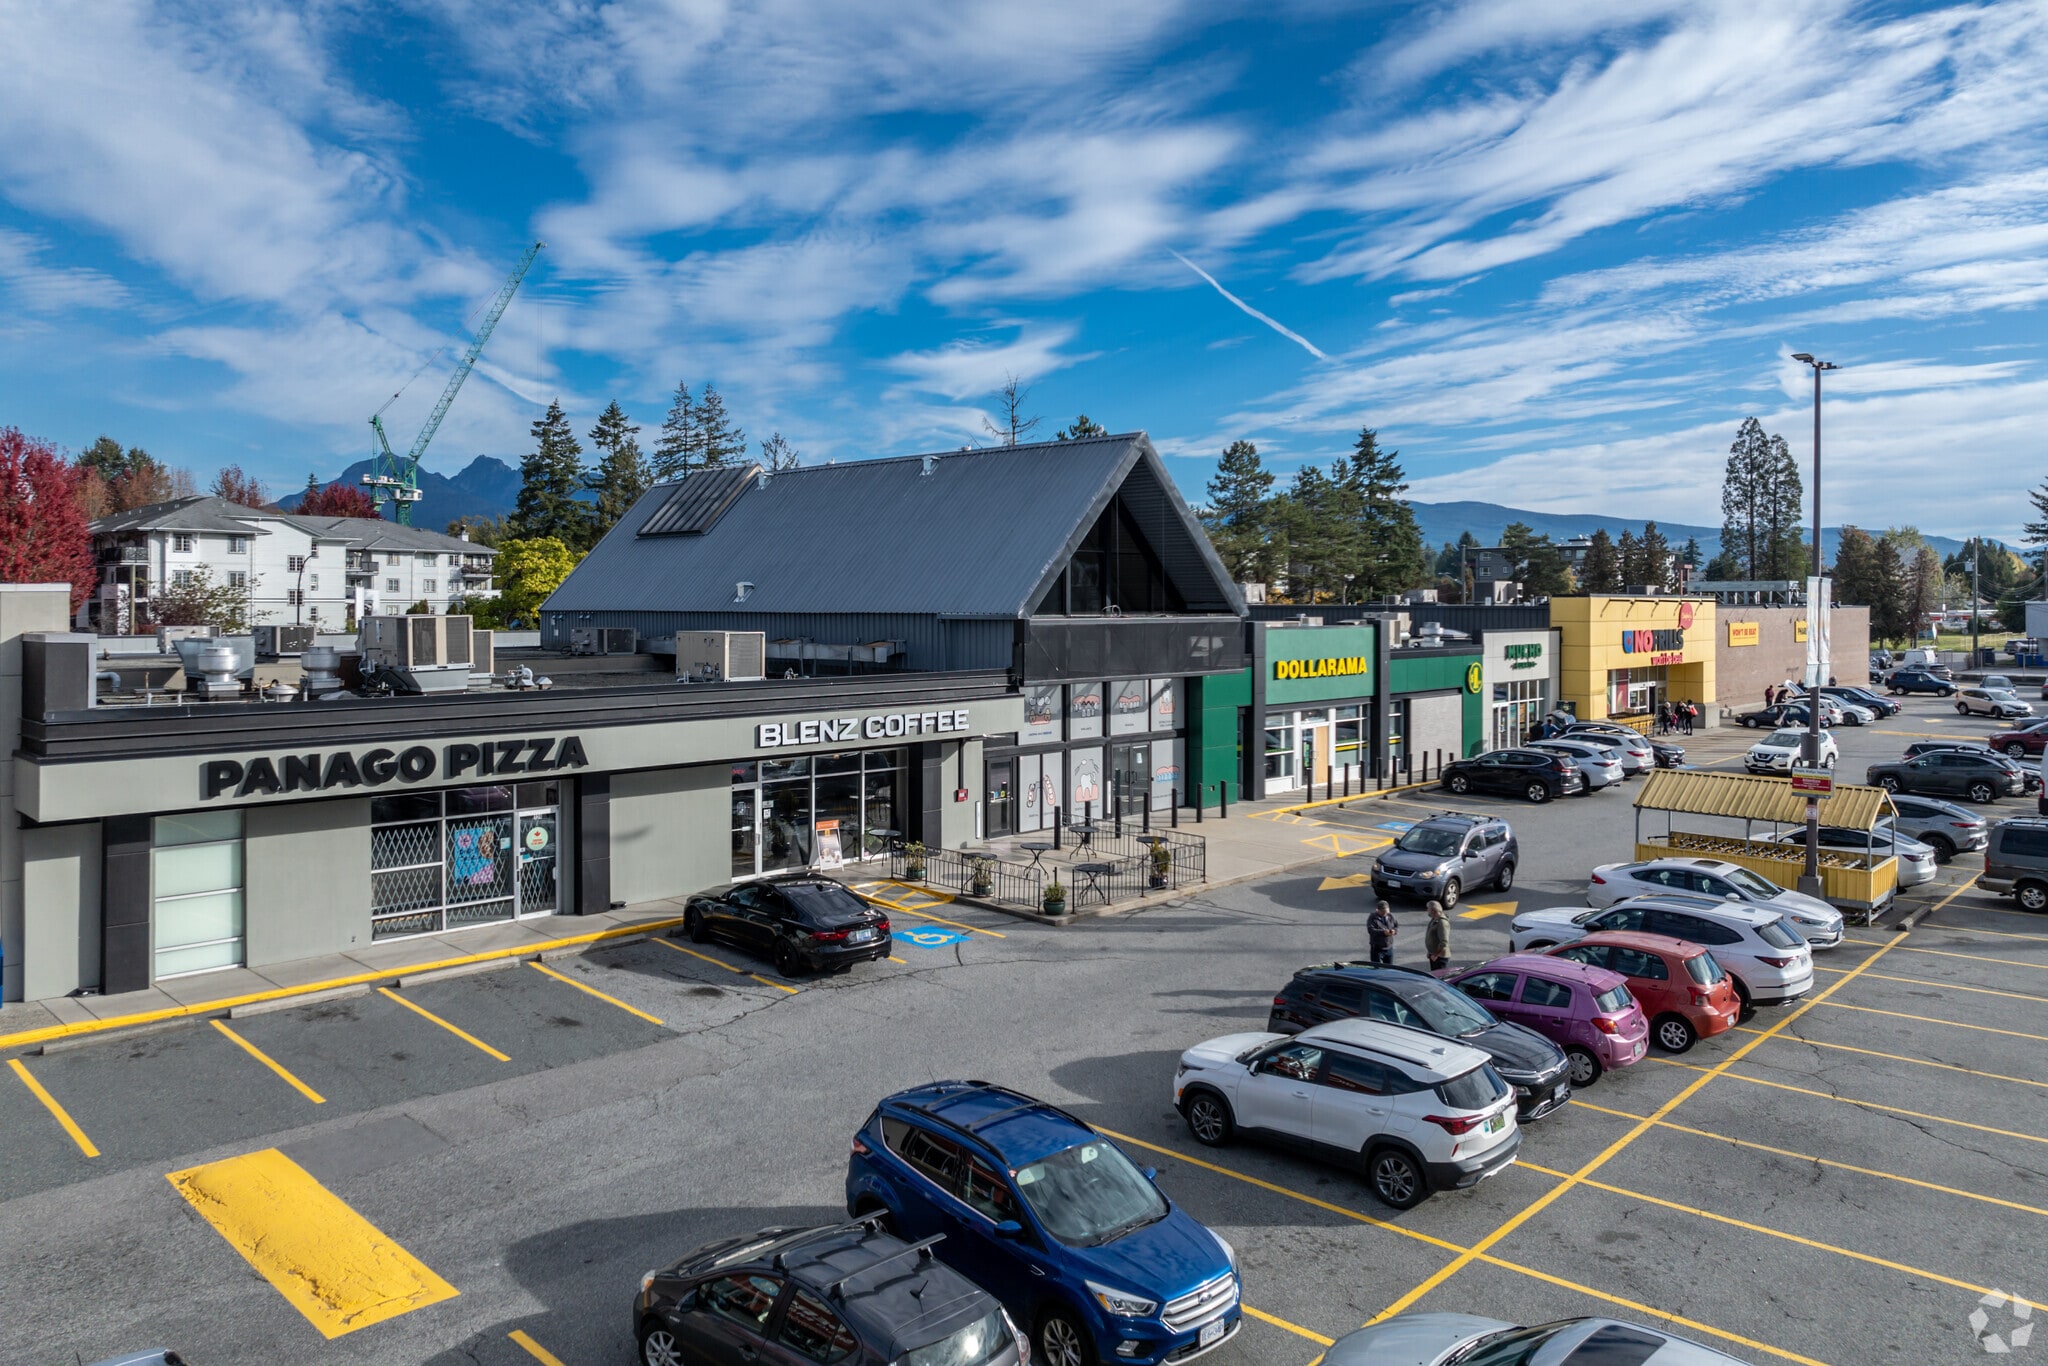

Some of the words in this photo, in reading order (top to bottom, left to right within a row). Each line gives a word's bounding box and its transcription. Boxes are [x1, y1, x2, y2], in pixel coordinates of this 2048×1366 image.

[1506, 643, 1542, 660] MUCHO
[1276, 656, 1368, 679] DOLLARAMA
[758, 717, 859, 748] BLENZ
[863, 709, 970, 738] COFFEE
[202, 745, 438, 799] PANAGO
[446, 735, 590, 779] PIZZA
